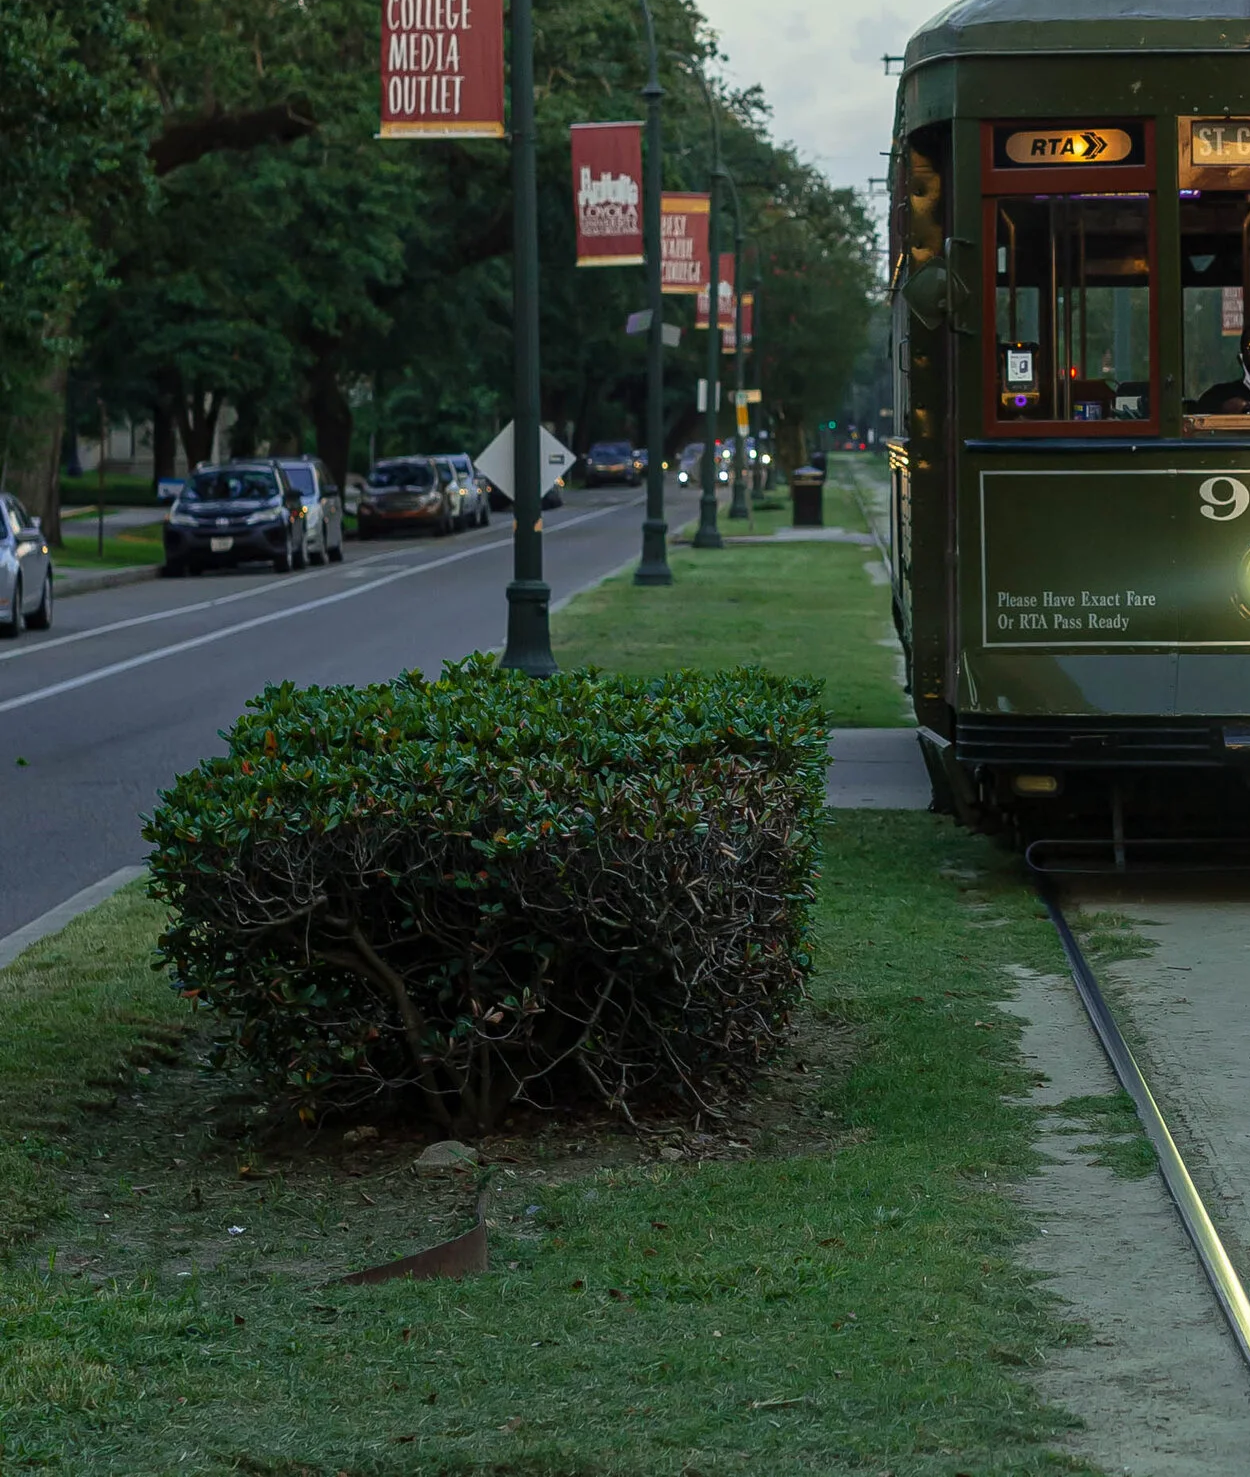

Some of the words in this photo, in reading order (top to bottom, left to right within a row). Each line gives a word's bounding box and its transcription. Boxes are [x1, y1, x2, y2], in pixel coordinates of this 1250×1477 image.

[388, 33, 460, 73] MEDIA
[388, 75, 465, 115] OUTLET
[1031, 138, 1075, 156] RTA
[1199, 127, 1231, 157] ST.
[998, 591, 1037, 608] Please
[1043, 591, 1075, 607] Have
[1081, 590, 1120, 607] Exact
[1127, 590, 1156, 607] Fare
[998, 614, 1014, 629] Or
[1020, 614, 1048, 629] RTA
[1054, 614, 1082, 629] Pass
[1088, 613, 1129, 631] Ready
